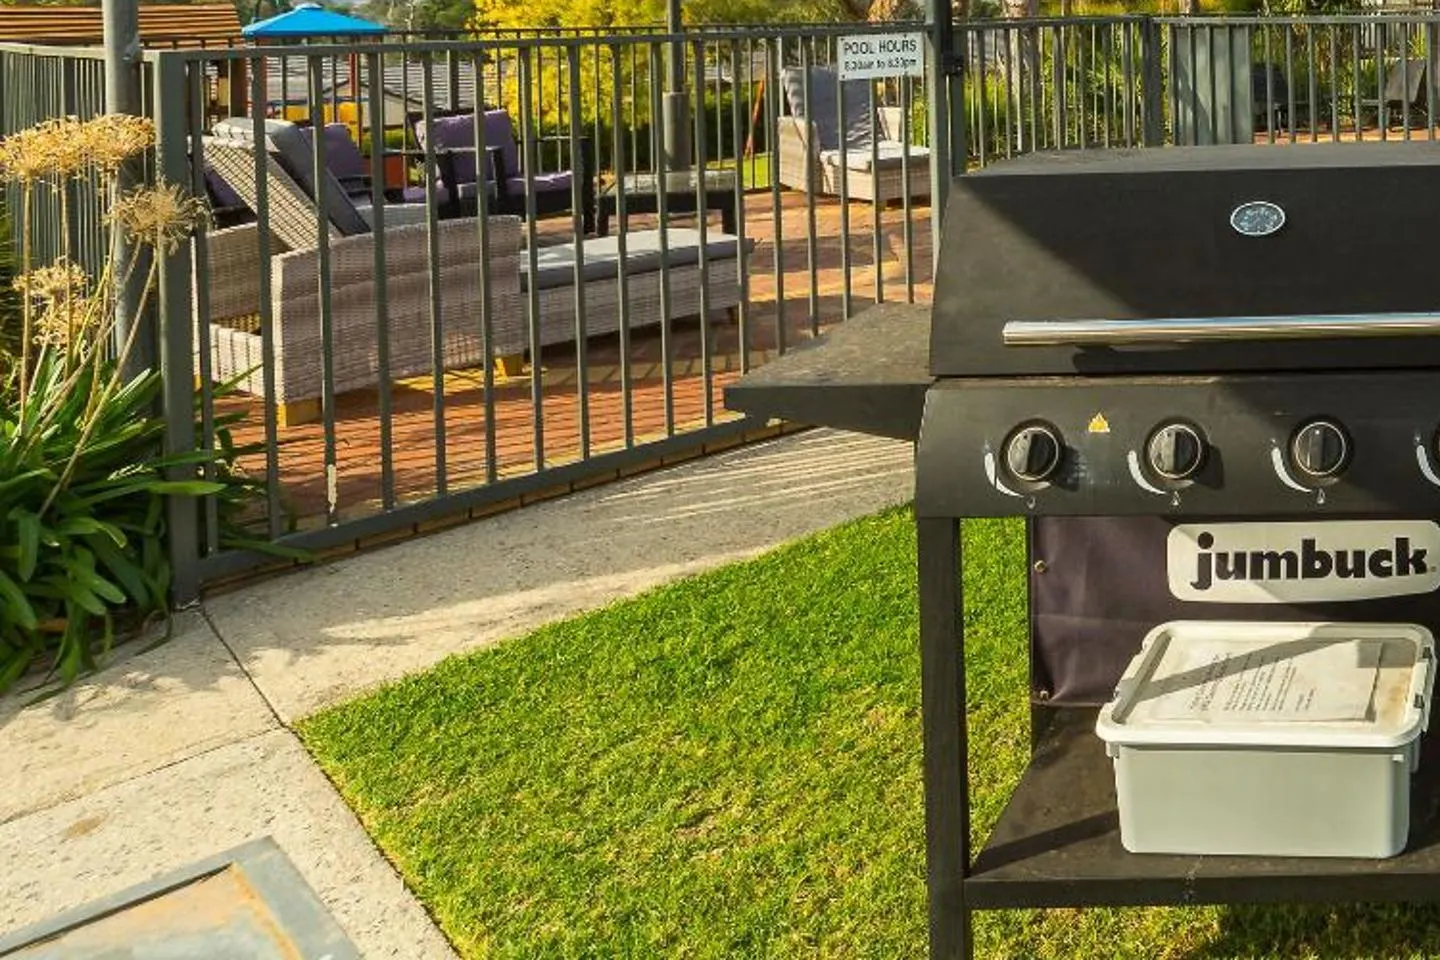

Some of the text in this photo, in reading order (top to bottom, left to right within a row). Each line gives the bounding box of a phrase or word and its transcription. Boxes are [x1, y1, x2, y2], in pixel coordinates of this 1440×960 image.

[844, 39, 917, 55] POOL HOURS
[1190, 531, 1428, 590] jumbuck
